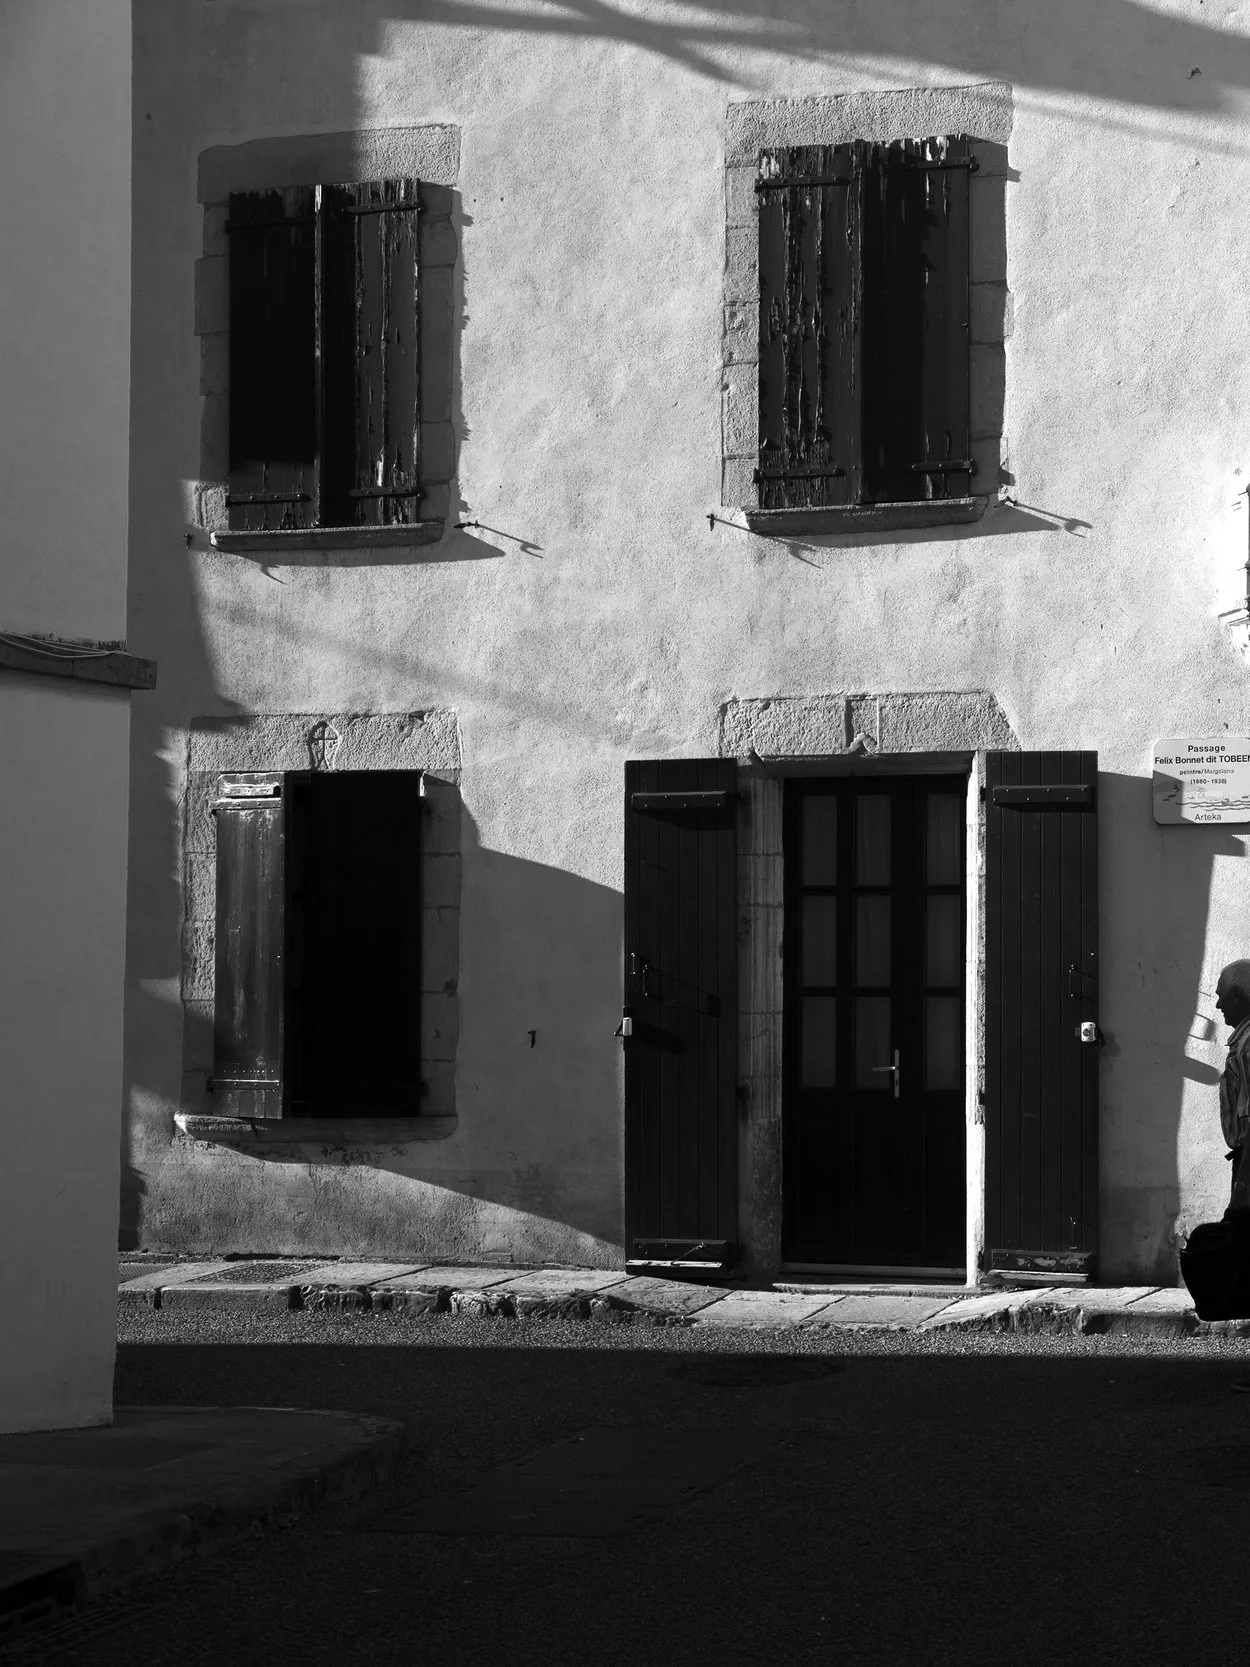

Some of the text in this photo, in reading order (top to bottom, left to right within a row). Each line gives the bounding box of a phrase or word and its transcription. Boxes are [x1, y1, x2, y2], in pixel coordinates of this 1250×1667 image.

[1187, 745, 1226, 753] Passage
[1154, 756, 1174, 765] Felix
[1175, 756, 1204, 764] Bonnet
[1206, 755, 1217, 763] dit
[1194, 813, 1222, 821] Arteka
